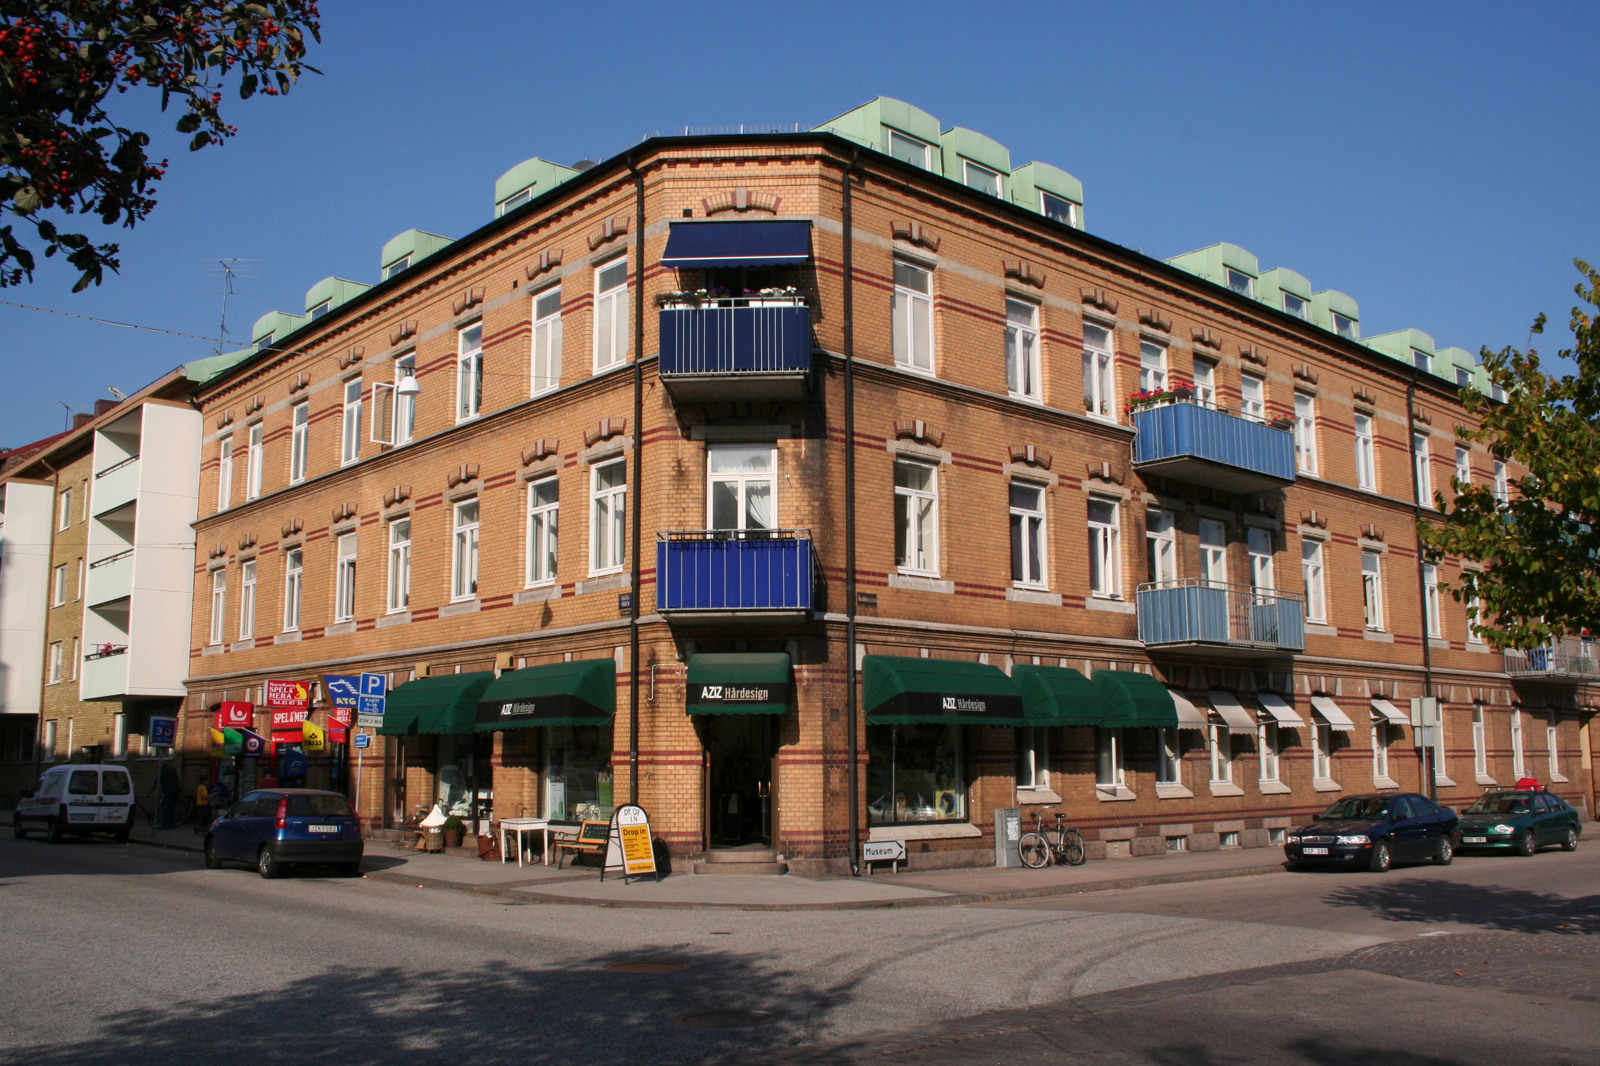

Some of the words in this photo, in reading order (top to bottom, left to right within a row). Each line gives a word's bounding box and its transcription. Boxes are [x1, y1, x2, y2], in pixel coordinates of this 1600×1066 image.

[368, 676, 381, 694] P
[701, 686, 722, 699] AZIZ
[724, 687, 769, 701] Hårdesign
[336, 697, 357, 705] ATG
[942, 697, 957, 710] AZIZ
[957, 698, 986, 711] Hårdesign
[500, 703, 513, 715] AZIZ
[273, 712, 289, 724] SPEL
